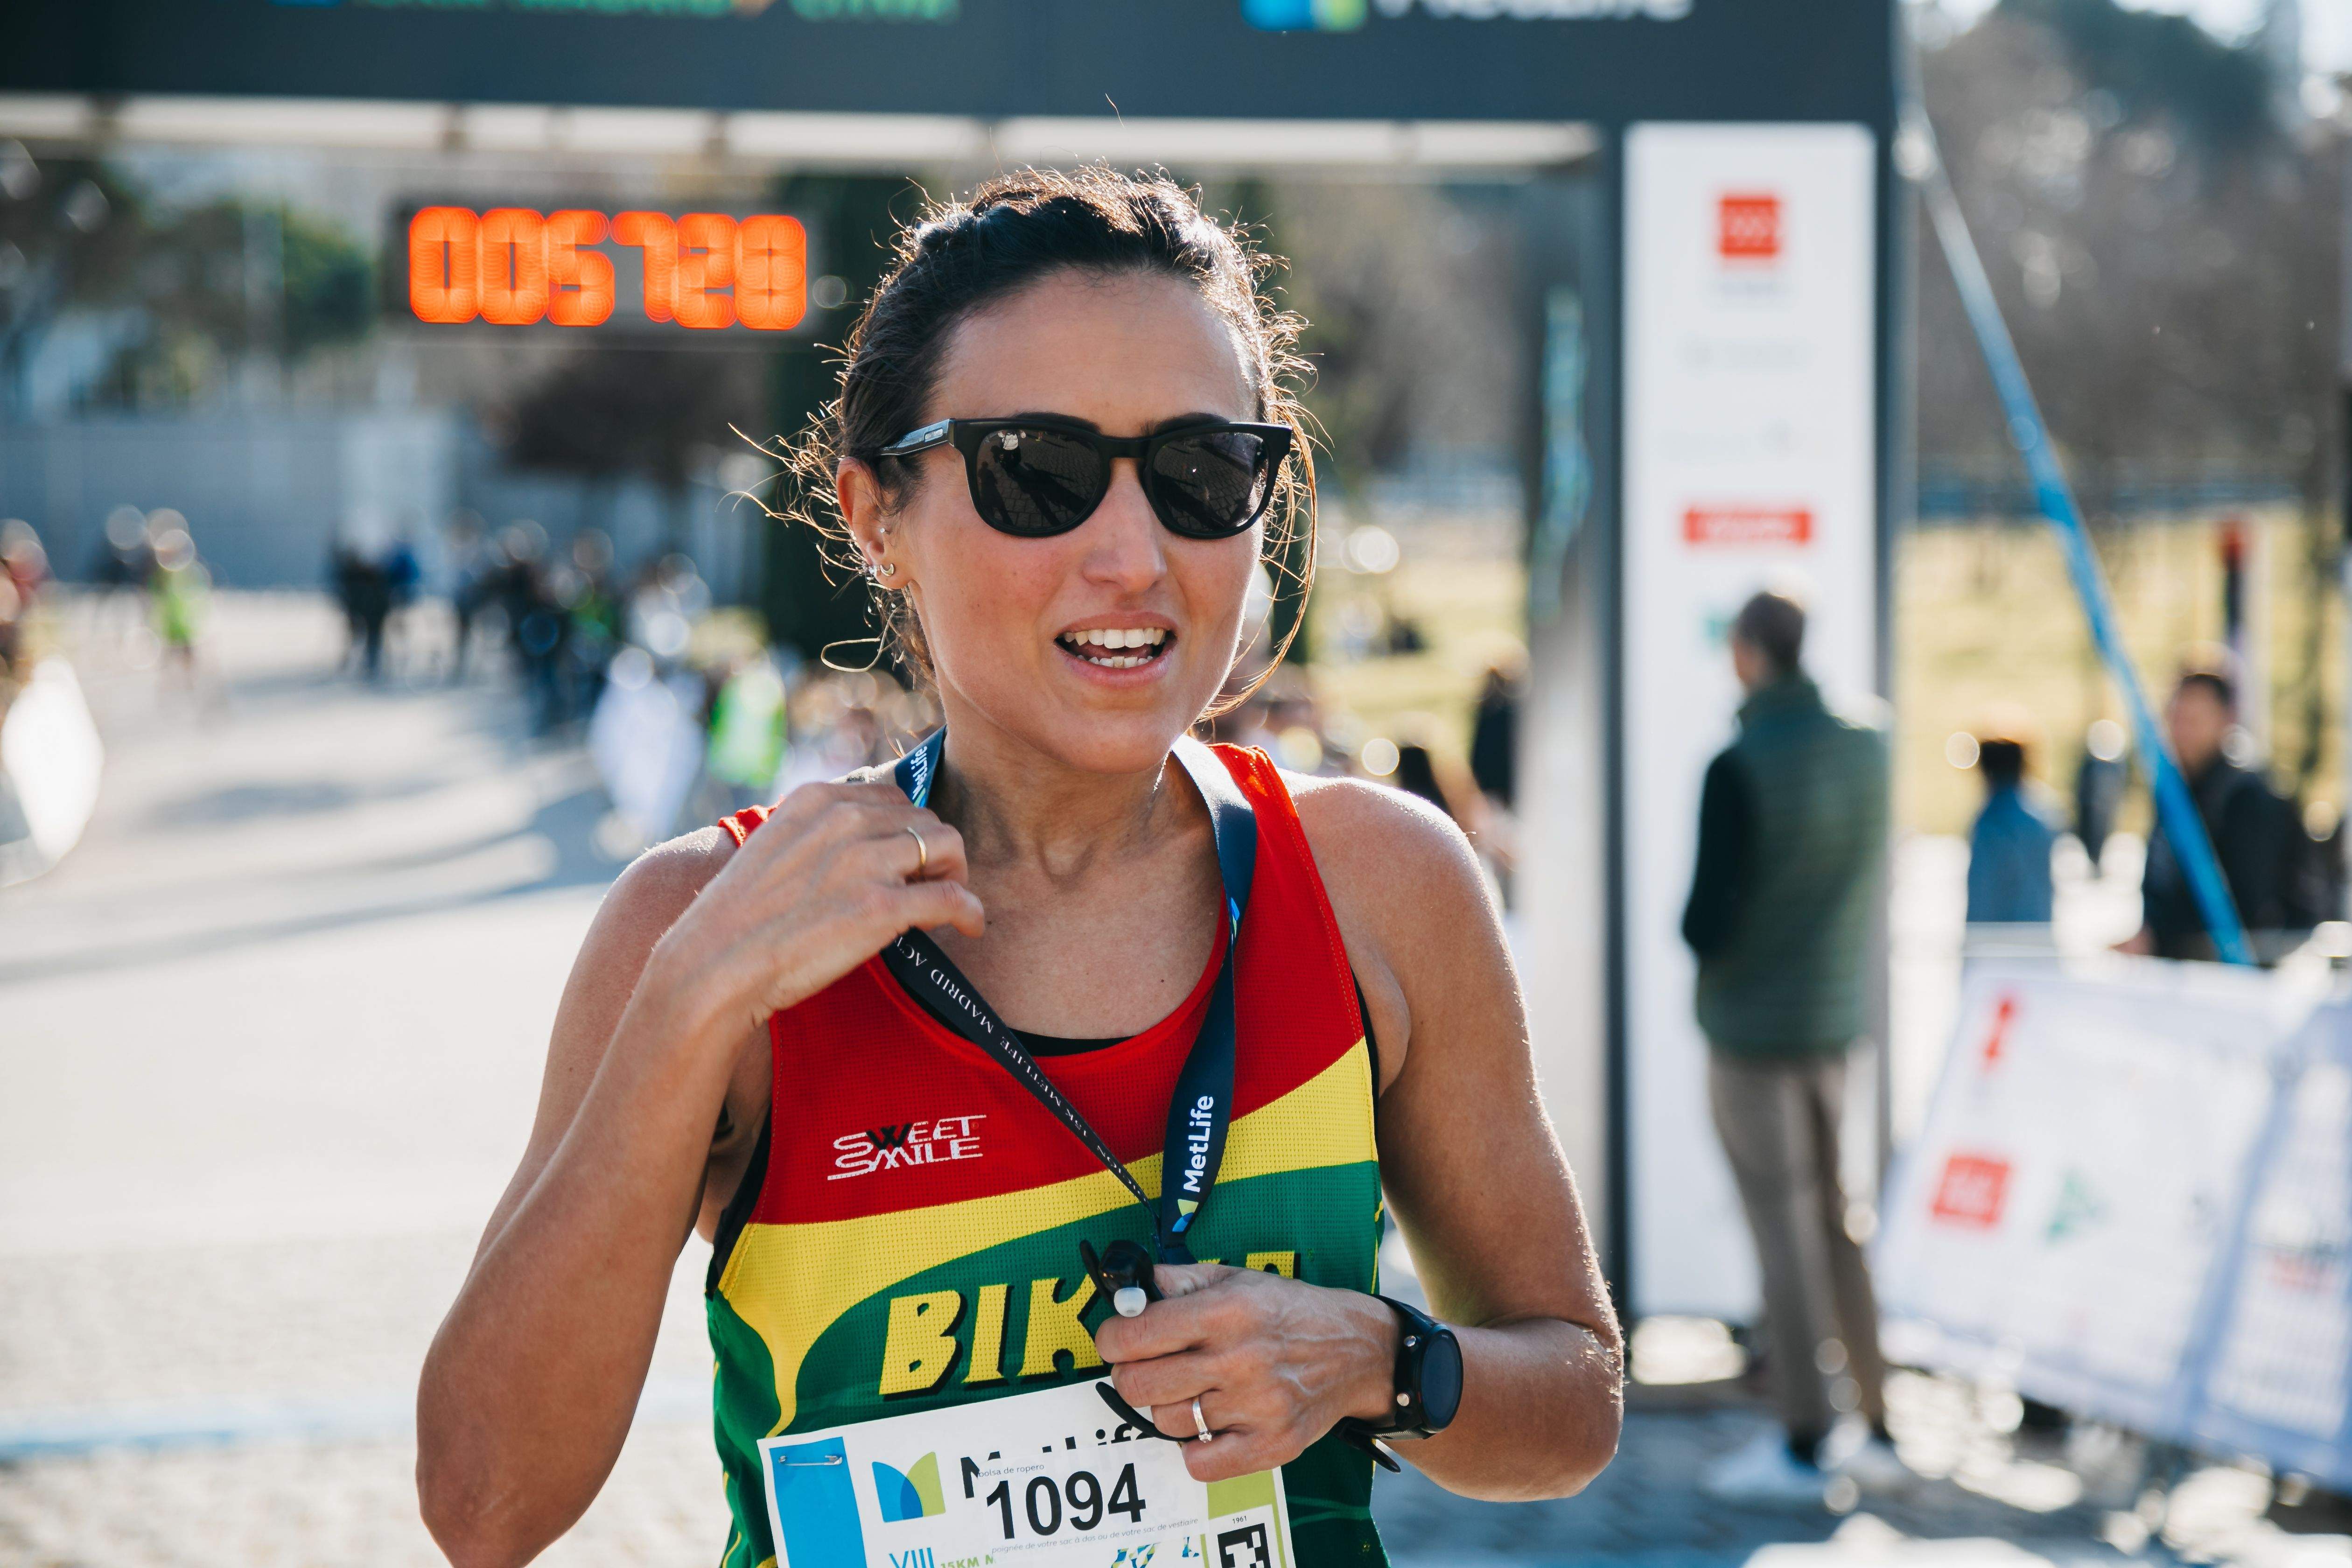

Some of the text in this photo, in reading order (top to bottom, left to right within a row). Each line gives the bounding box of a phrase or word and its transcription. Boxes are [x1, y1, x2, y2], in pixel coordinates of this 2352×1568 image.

[409, 206, 807, 330] 005728
[910, 746, 928, 800] MetLife
[931, 969, 994, 1034] MADRID
[1001, 1036, 1061, 1106] METLIFE
[833, 1114, 987, 1155] SWEET
[1065, 1108, 1086, 1136] 15K
[1183, 1095, 1214, 1192] MetLife
[827, 1137, 984, 1181] SMILE
[1017, 1464, 1044, 1474] ropero
[987, 1463, 1147, 1540] 1094
[1232, 1516, 1247, 1524] 1961
[889, 1547, 935, 1568] VIII
[992, 1544, 1023, 1554] poignée
[1169, 1518, 1199, 1529] vestiaire
